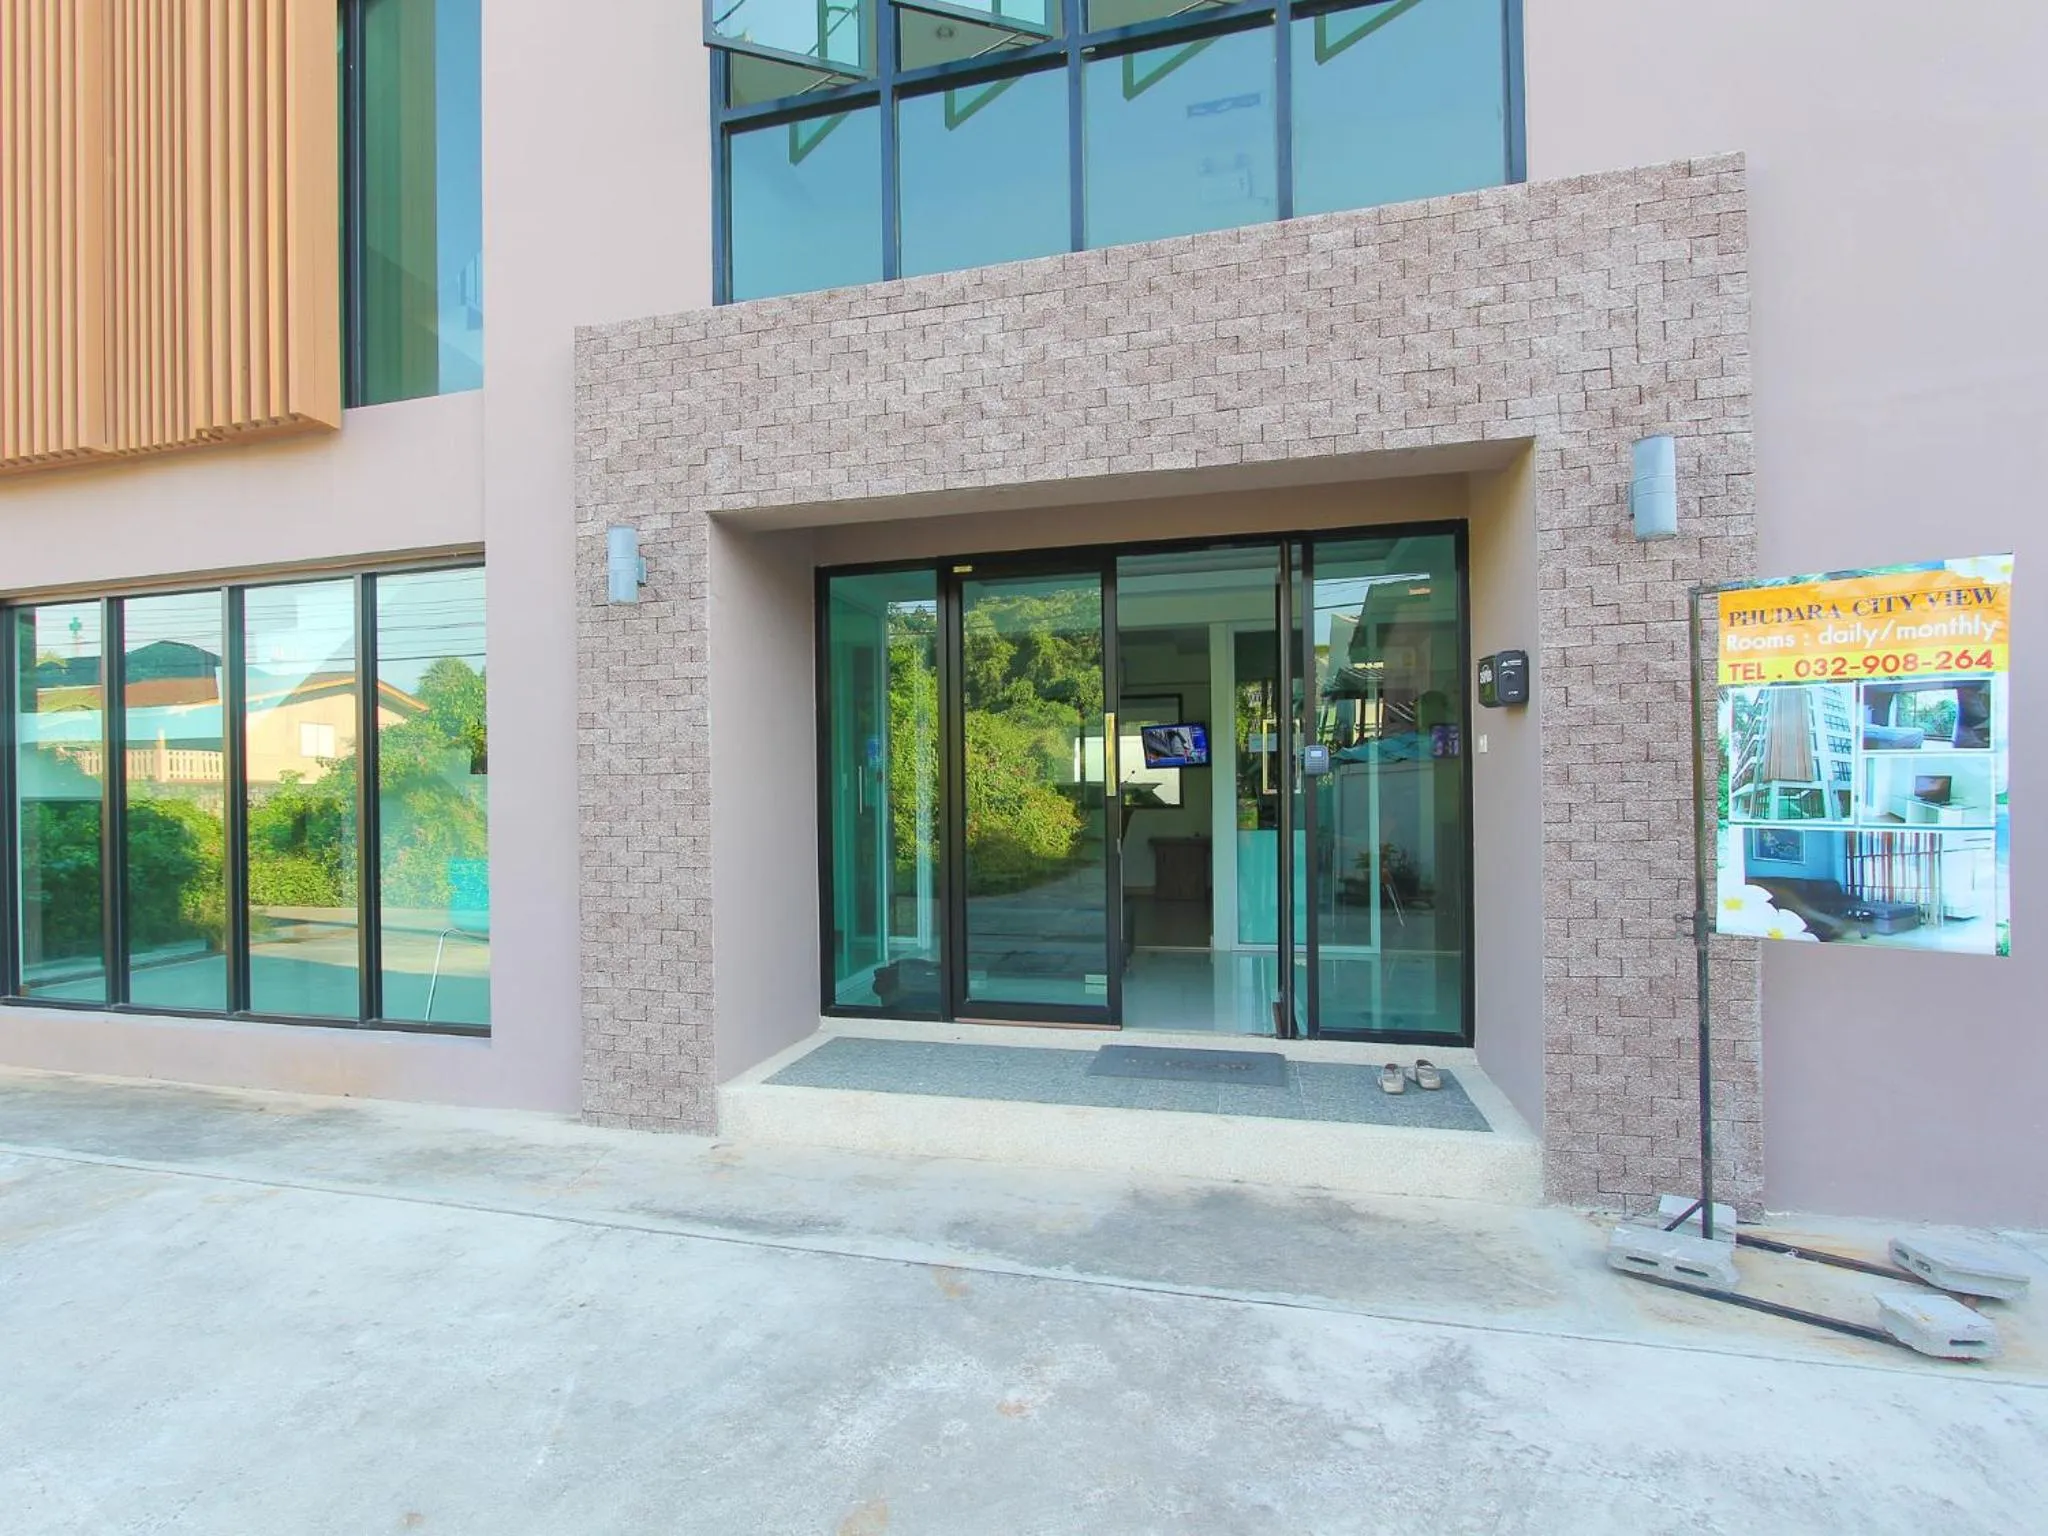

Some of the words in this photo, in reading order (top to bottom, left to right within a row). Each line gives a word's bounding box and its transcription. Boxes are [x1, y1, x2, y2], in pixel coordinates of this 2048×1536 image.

[1728, 604, 1841, 627] PHUDARA
[1853, 593, 1918, 617] CITY
[1925, 586, 2000, 607] VIEW
[1726, 631, 1796, 651] Rooms
[1728, 662, 1766, 682] TEL
[1794, 649, 1994, 678] 032-908-264
